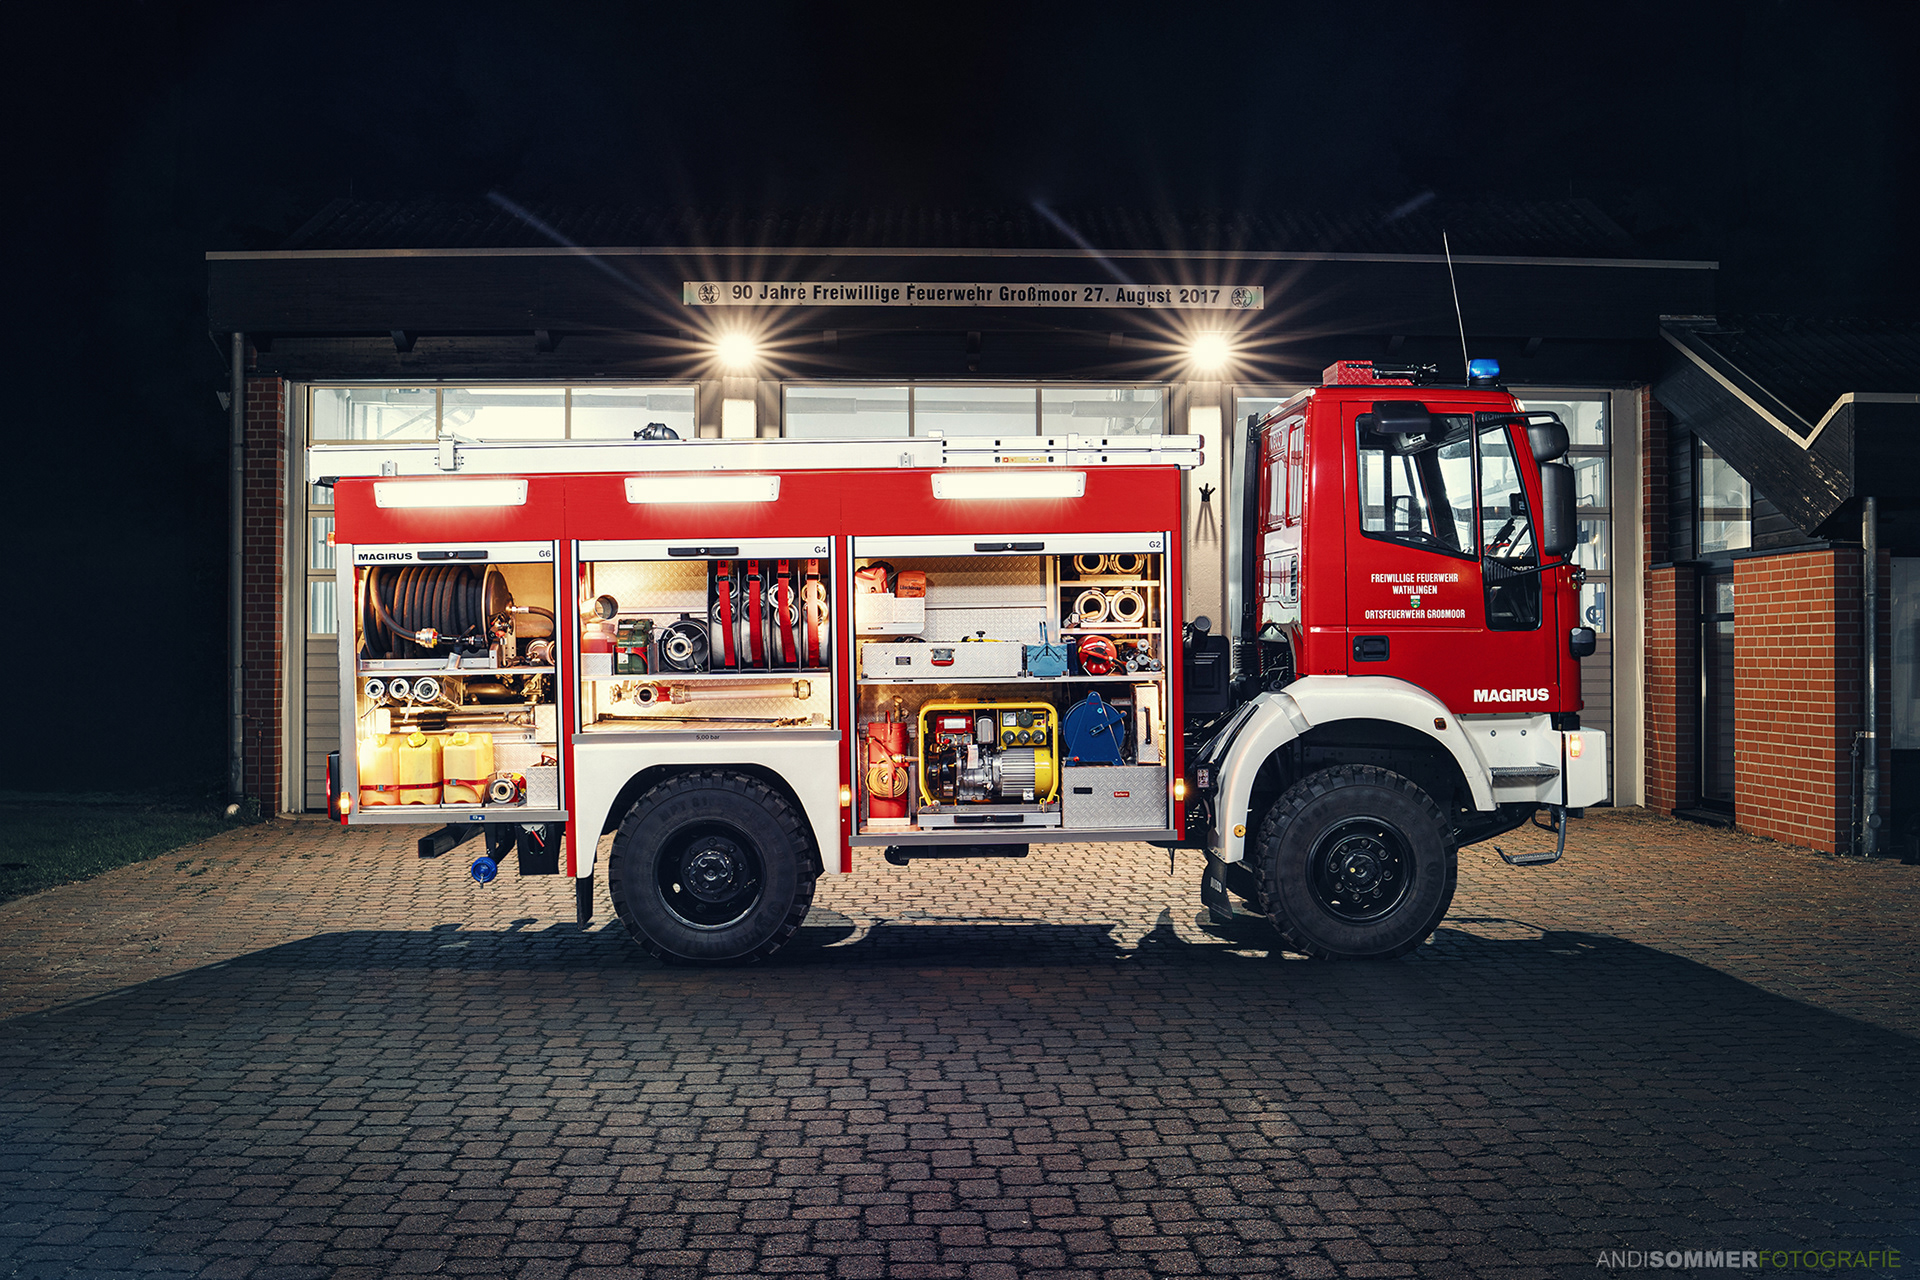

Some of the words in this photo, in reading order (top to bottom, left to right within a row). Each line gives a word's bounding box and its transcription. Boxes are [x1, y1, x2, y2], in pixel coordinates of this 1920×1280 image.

[732, 285, 753, 300] 90
[760, 285, 806, 300] Jahre
[813, 285, 900, 302] Freiwillige
[907, 286, 993, 301] Feuerwehr
[999, 286, 1077, 302] Großmoor
[1084, 287, 1109, 303] 27.
[1116, 287, 1172, 305] August
[1179, 288, 1220, 303] 2017
[814, 545, 826, 554] G4
[1148, 540, 1161, 549] G2
[358, 552, 413, 561] MAGIRUS
[538, 550, 551, 558] G6
[1370, 573, 1415, 583] FREIWILLIGE
[1416, 573, 1459, 583] FEUERWEHR
[1392, 585, 1438, 595] WATHLINGEN
[1365, 609, 1425, 620] ORTSFEUERWEHR
[1473, 687, 1550, 702] MAGIRUS
